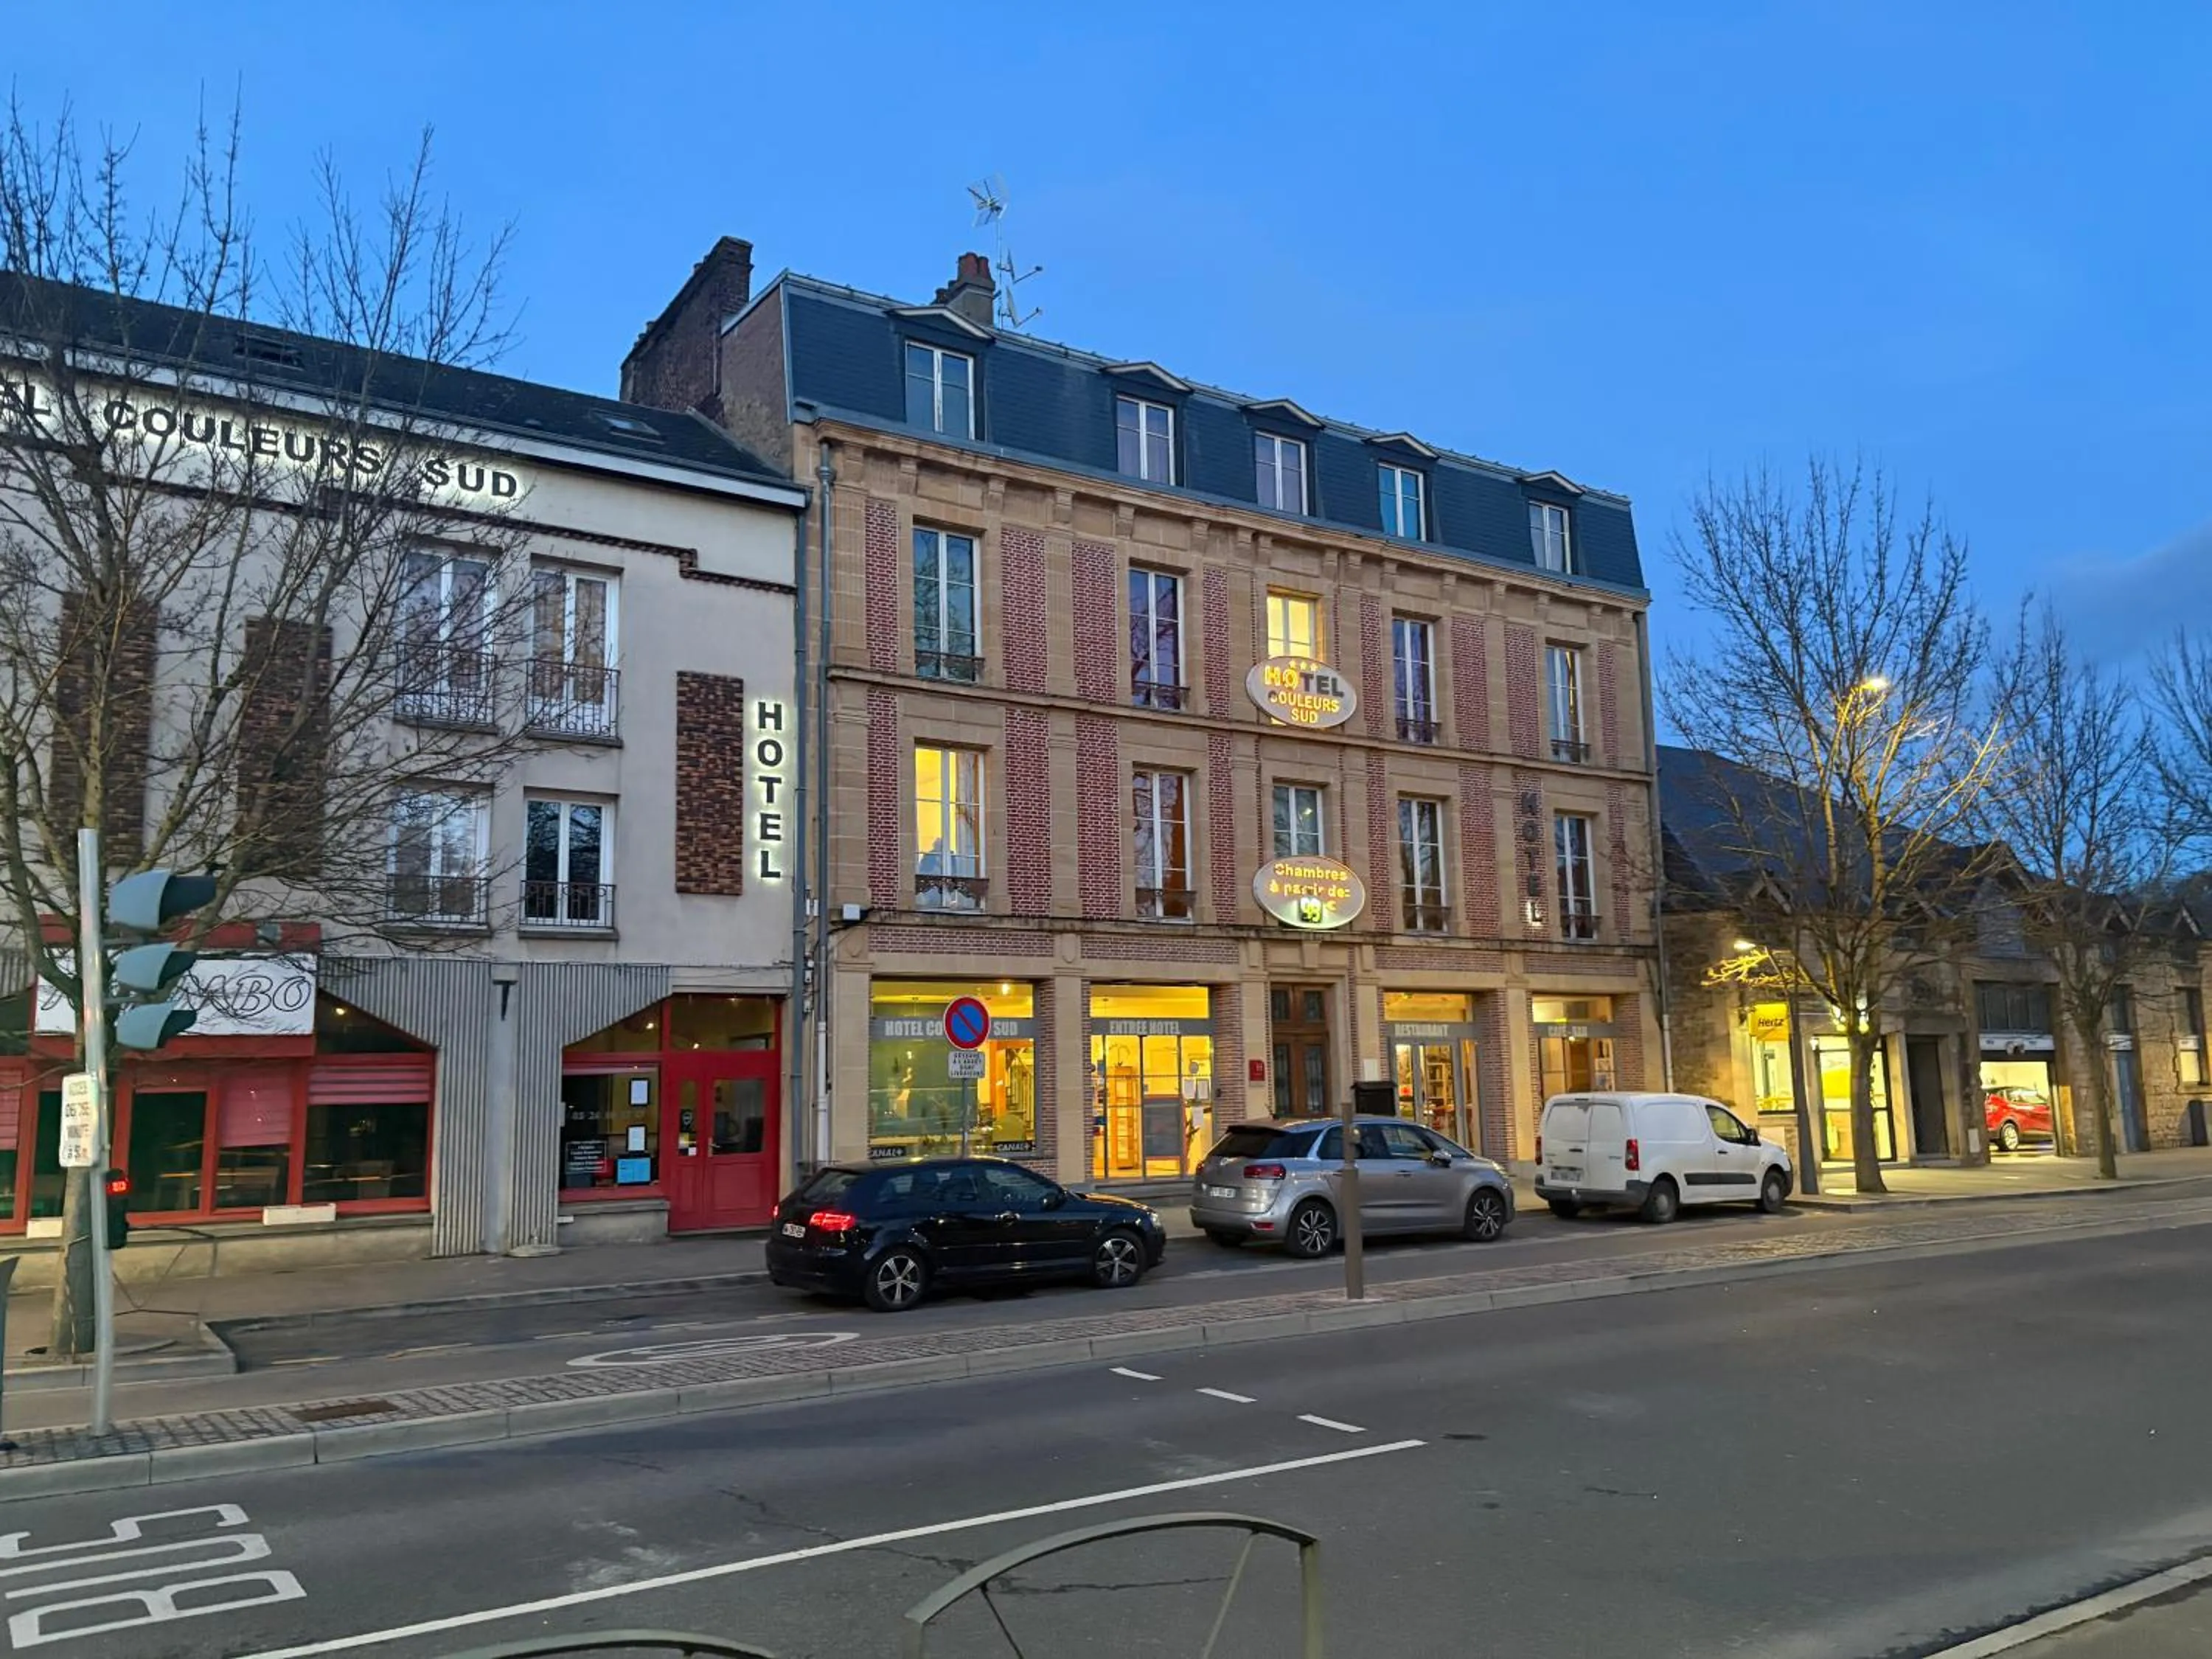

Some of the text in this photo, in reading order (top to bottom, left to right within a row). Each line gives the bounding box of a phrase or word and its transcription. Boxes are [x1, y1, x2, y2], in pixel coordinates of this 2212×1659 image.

[103, 400, 382, 474] COULEURS
[424, 457, 517, 498] SUD
[1268, 690, 1340, 713] COULEURS
[1291, 709, 1318, 723] SUD
[757, 701, 783, 879] HOTEL
[1274, 863, 1349, 881] Chambres
[884, 1020, 924, 1036] HOTEL
[993, 1020, 1018, 1036] SUD
[1150, 1020, 1180, 1034] HOTEL
[1394, 1023, 1449, 1037] RESTAURANT
[1759, 1018, 1784, 1027] Hertz
[872, 1148, 903, 1157] ANAL+
[997, 1143, 1029, 1152] CANAL+
[0, 1504, 307, 1649] BUS
